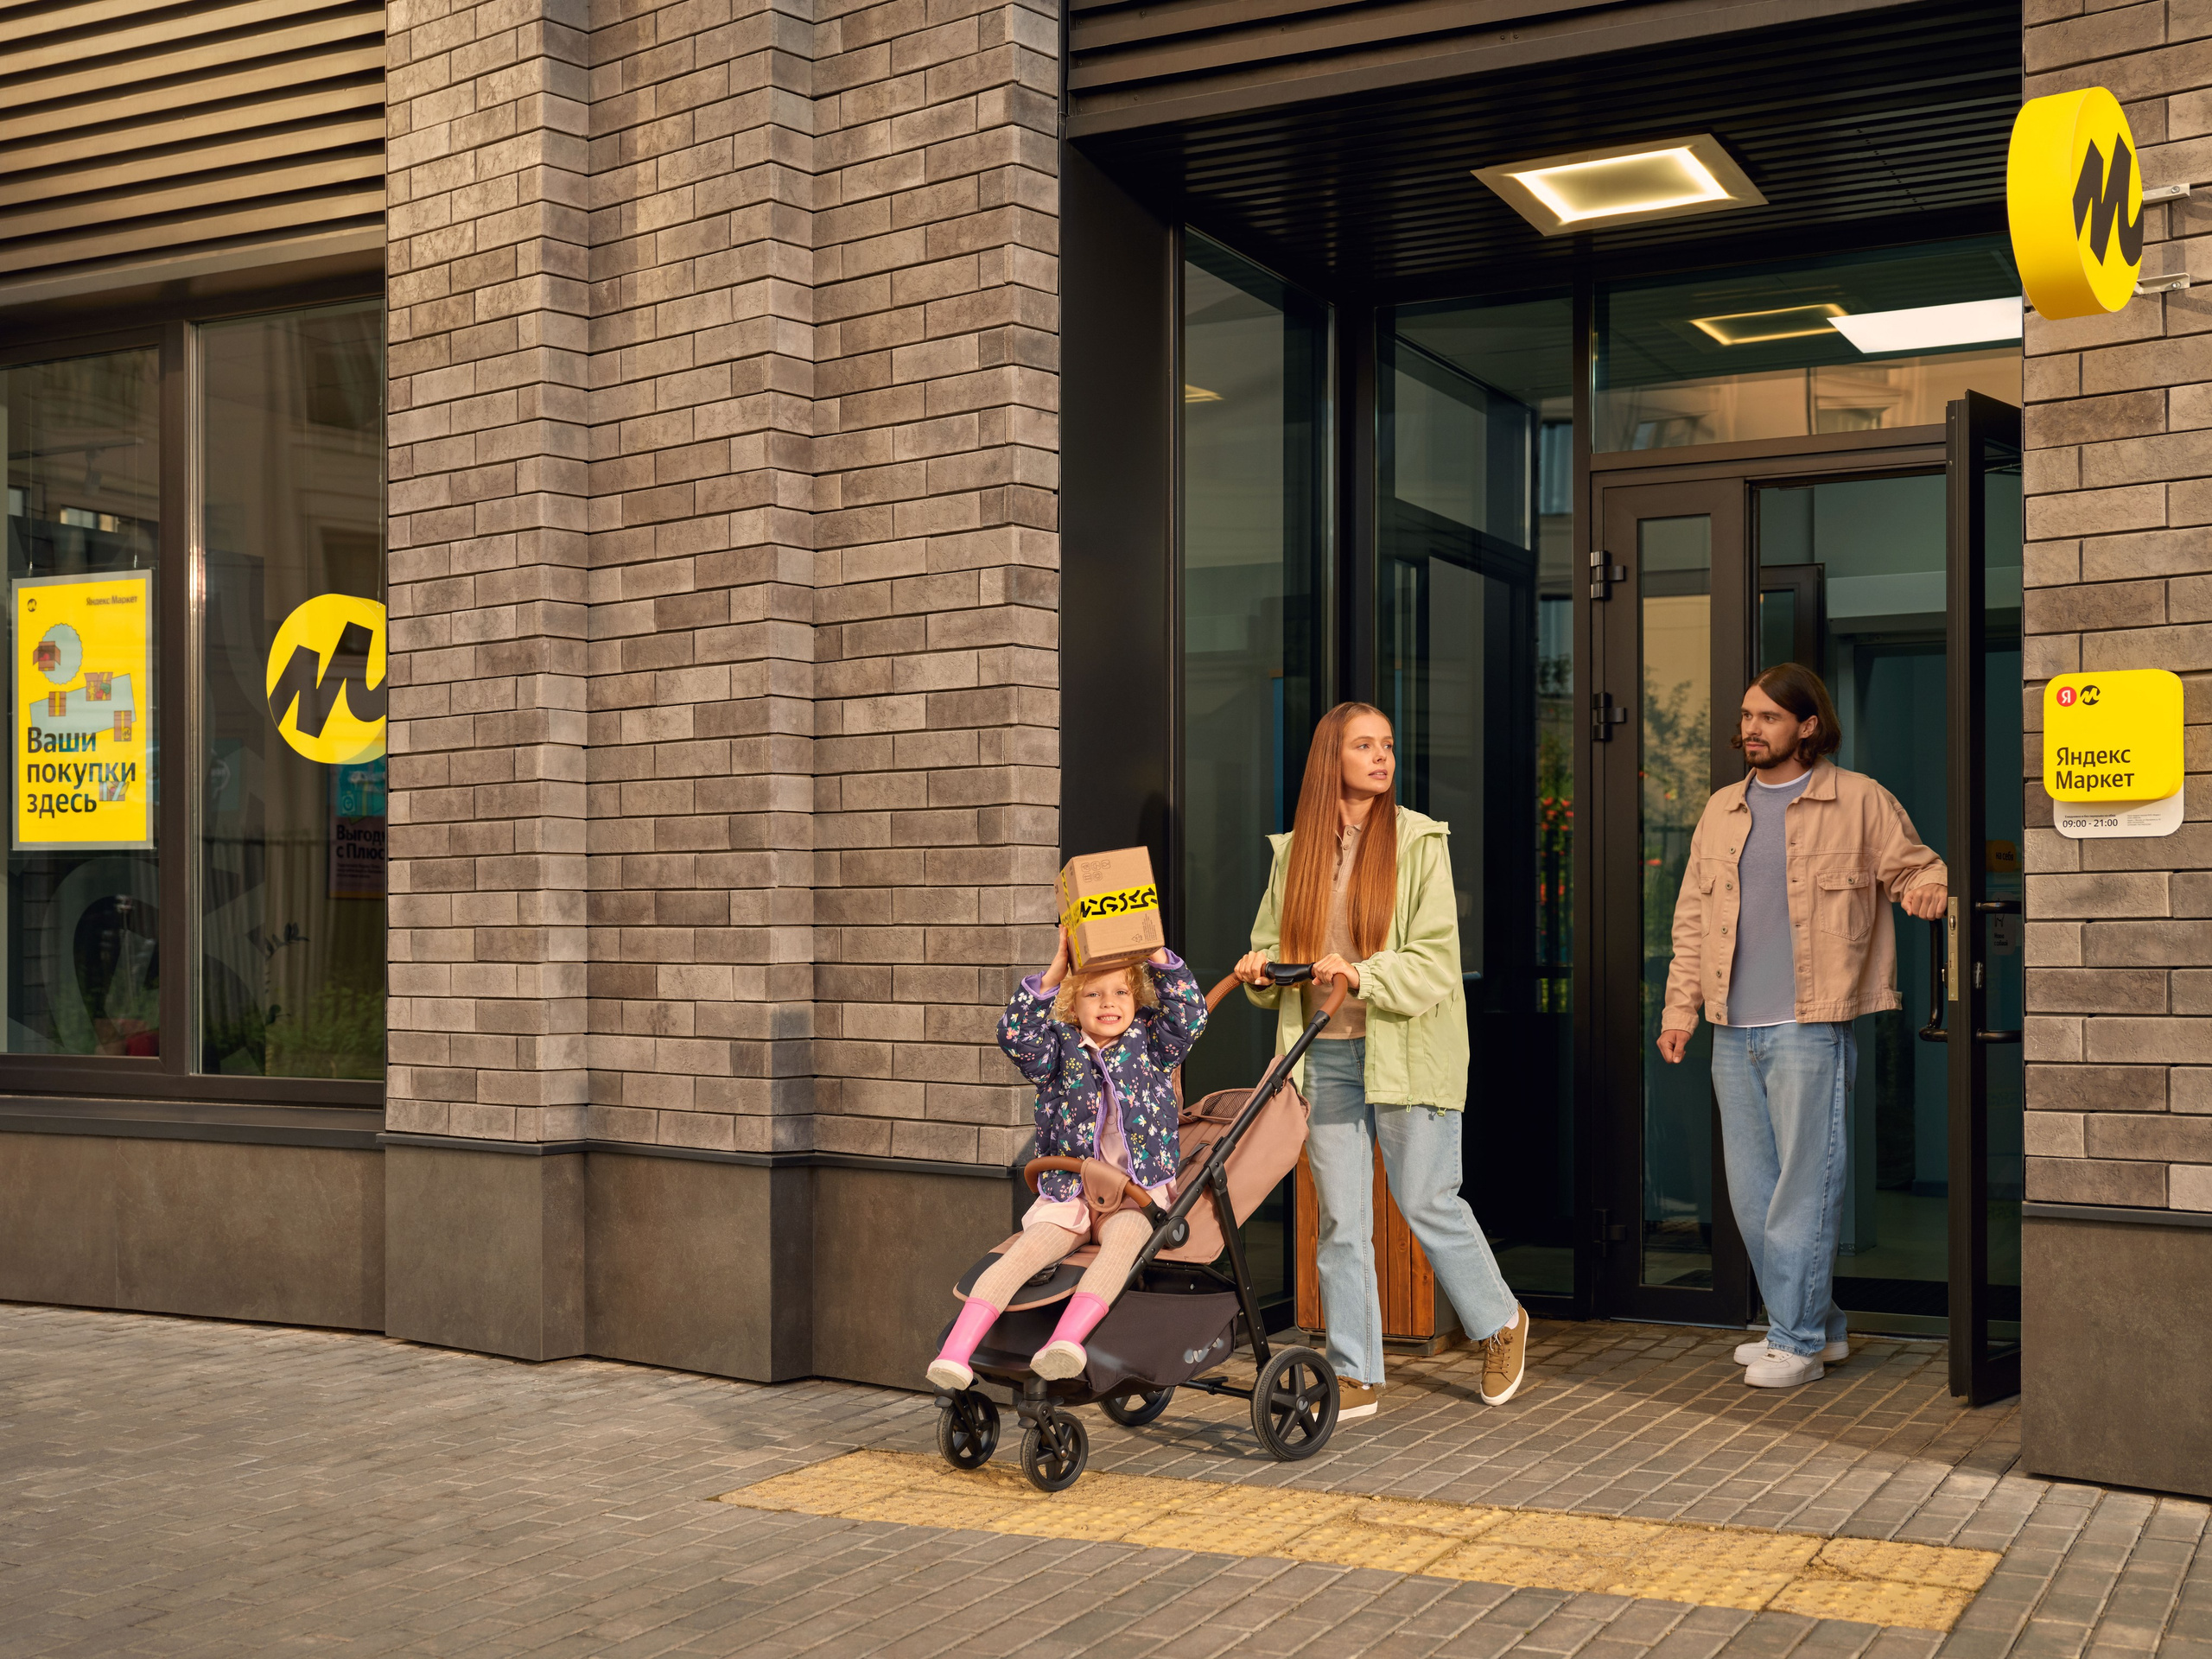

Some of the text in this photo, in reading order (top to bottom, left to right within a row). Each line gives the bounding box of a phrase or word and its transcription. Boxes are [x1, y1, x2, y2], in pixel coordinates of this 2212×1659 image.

[111, 595, 137, 605] Маркет
[27, 726, 97, 753] Ваши
[2056, 747, 2132, 767] Яндекс
[27, 762, 136, 790] покупки
[2056, 771, 2135, 792] Маркет
[27, 793, 98, 818] здесь
[2063, 819, 2087, 828] 09:00
[2094, 818, 2118, 827] 21:00
[336, 846, 344, 858] с
[2003, 851, 2013, 861] себя
